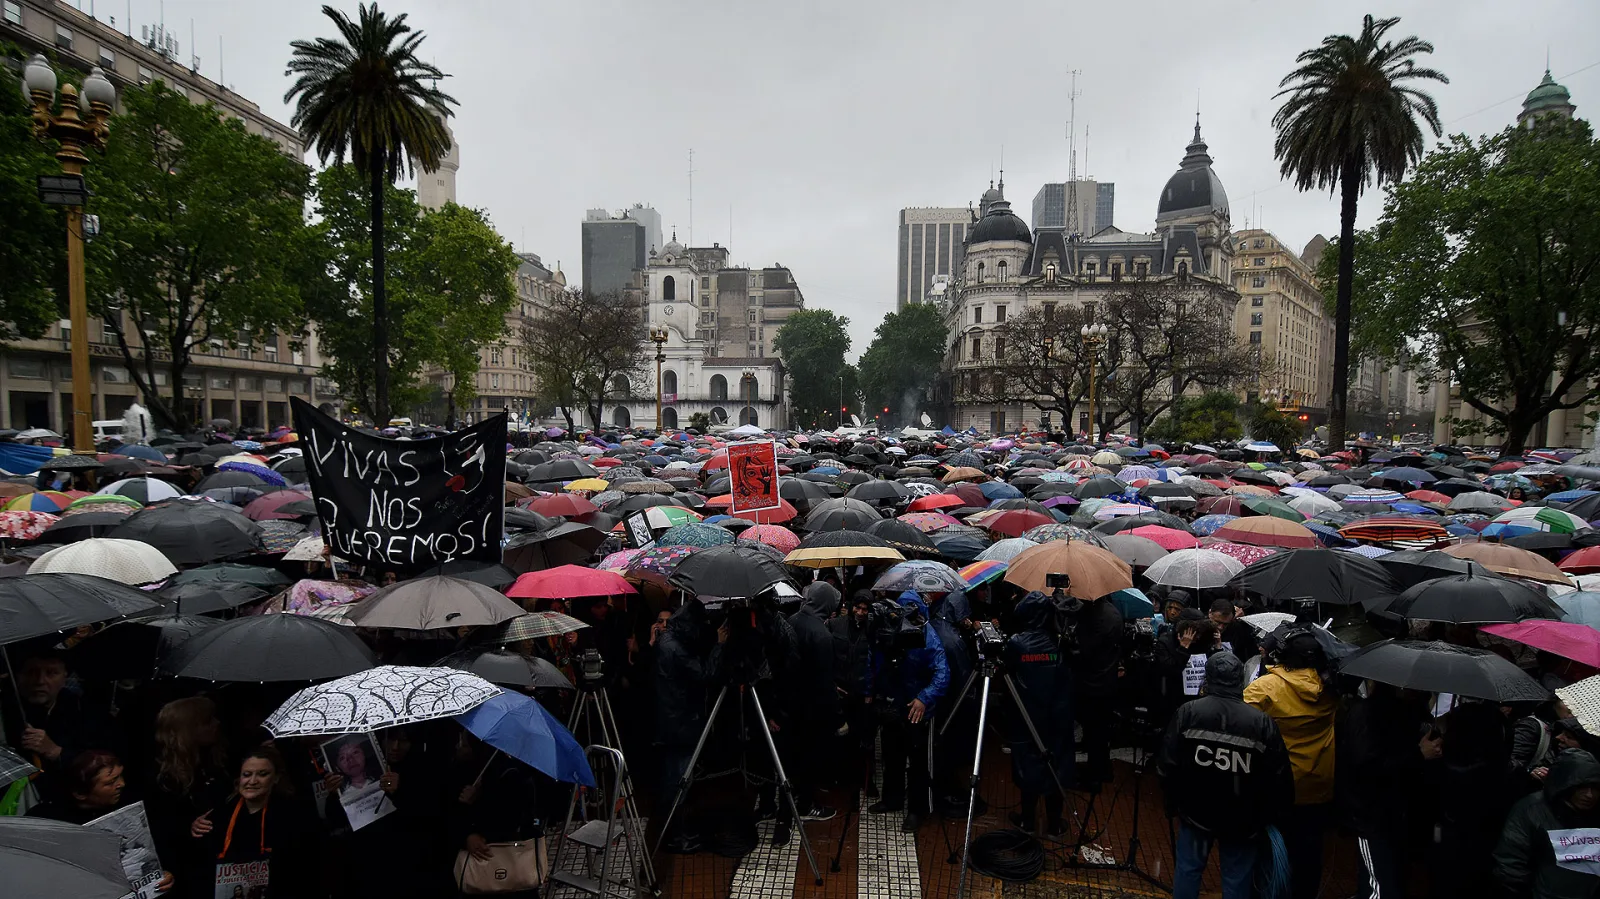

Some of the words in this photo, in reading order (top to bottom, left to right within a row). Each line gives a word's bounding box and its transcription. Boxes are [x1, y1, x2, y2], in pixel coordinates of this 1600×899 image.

[88, 345, 125, 357] FRANC
[366, 488, 421, 531] NOS
[1194, 744, 1252, 774] C5N
[1559, 835, 1600, 847] #Vivas
[218, 862, 268, 878] JUSTICIA
[133, 870, 162, 891] para
